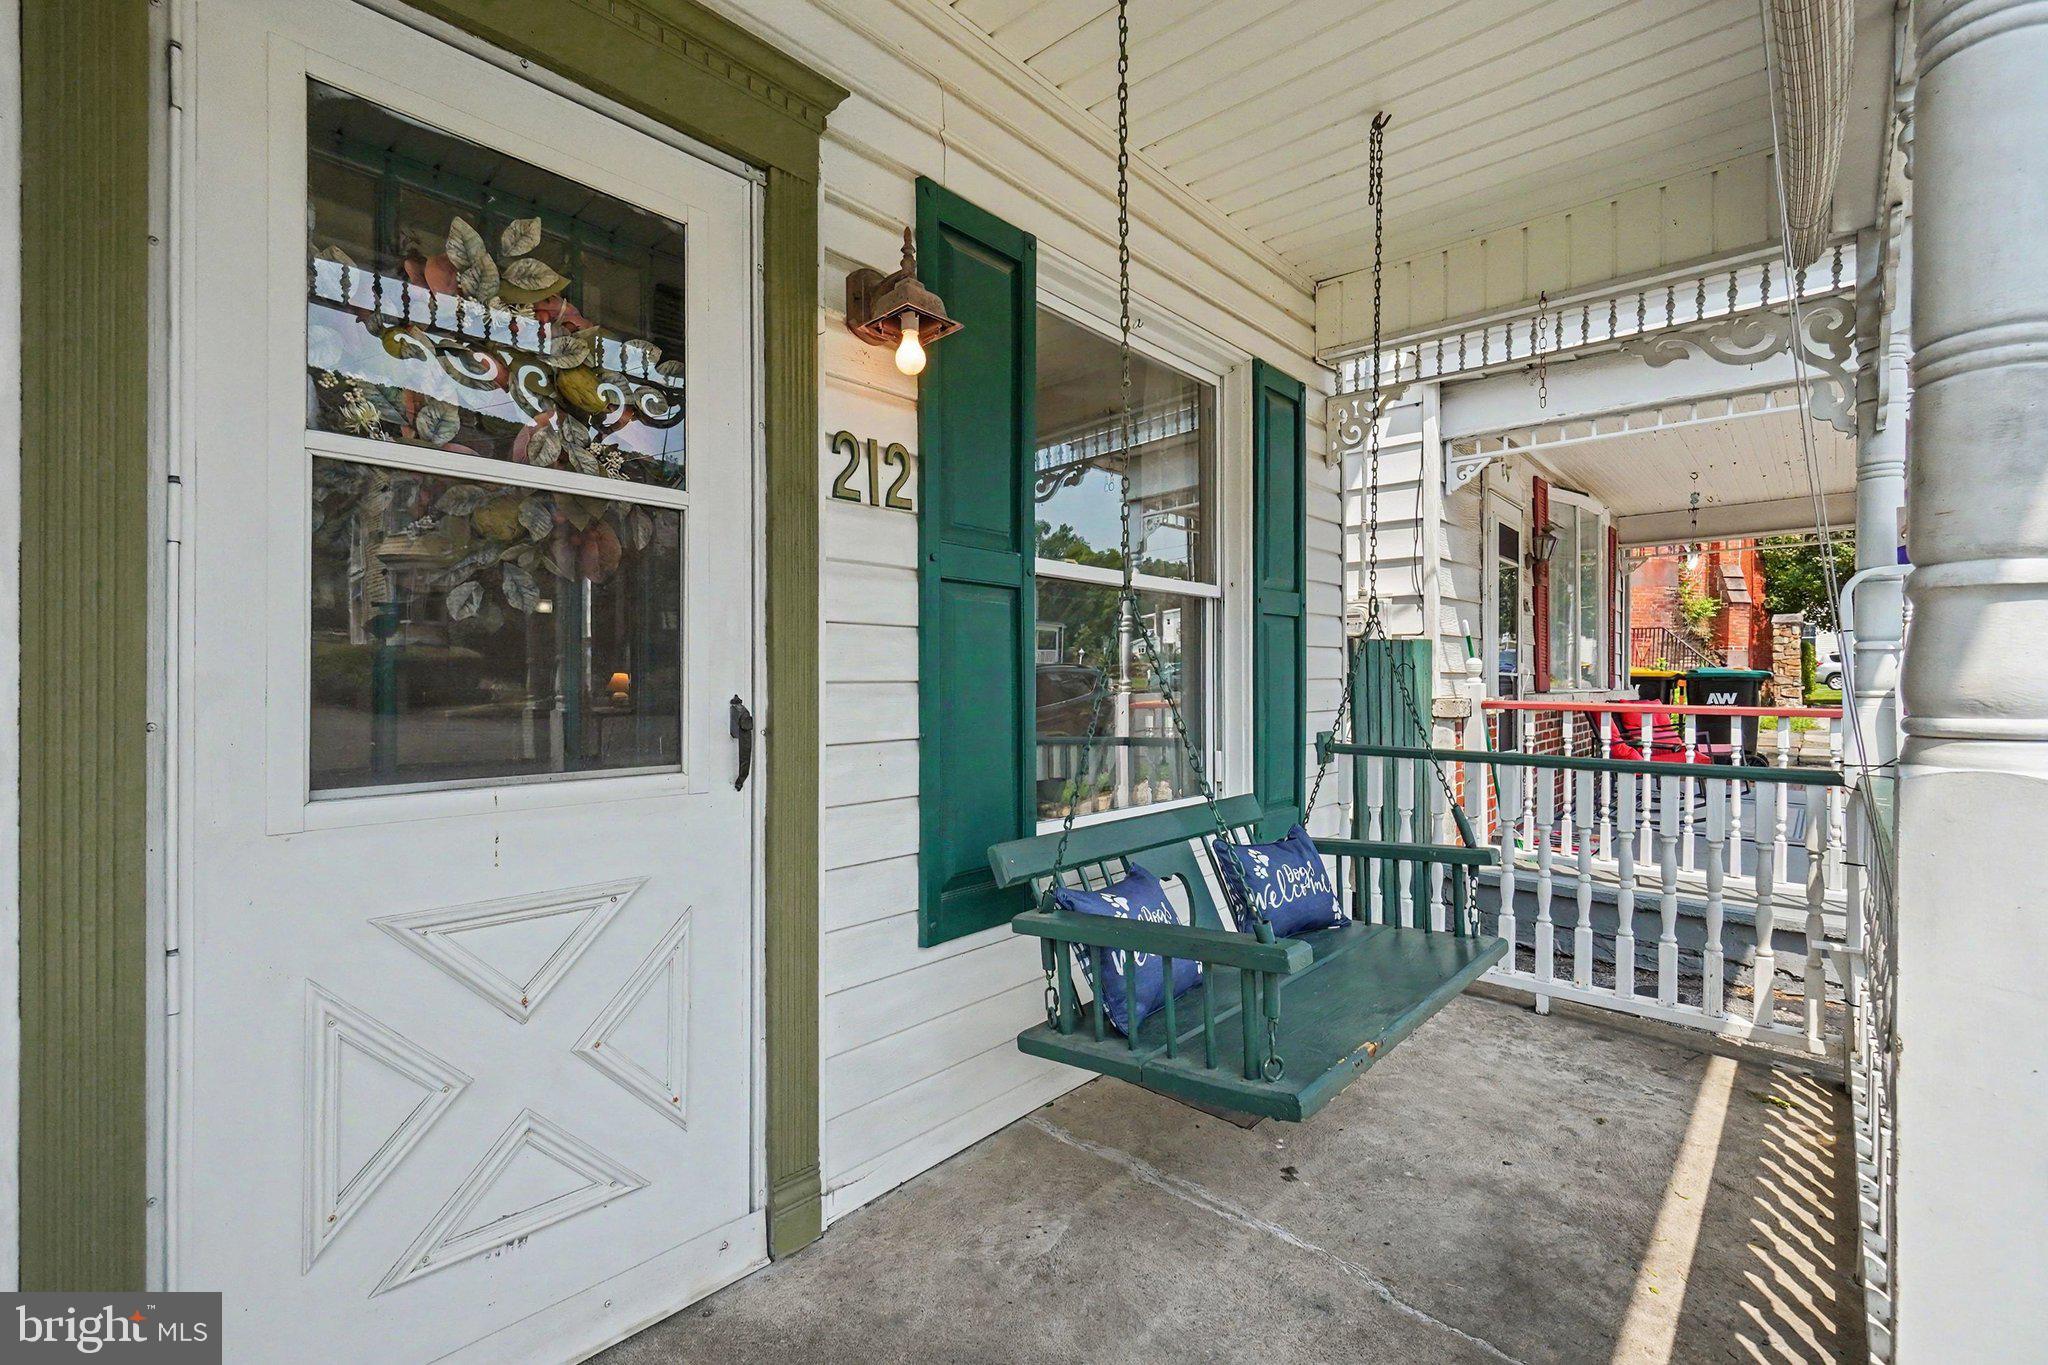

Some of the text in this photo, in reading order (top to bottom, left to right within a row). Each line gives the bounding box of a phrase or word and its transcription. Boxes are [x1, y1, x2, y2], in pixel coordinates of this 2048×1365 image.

[832, 430, 912, 510] 212
[1706, 692, 1738, 705] AW
[1281, 861, 1315, 883] Dogs
